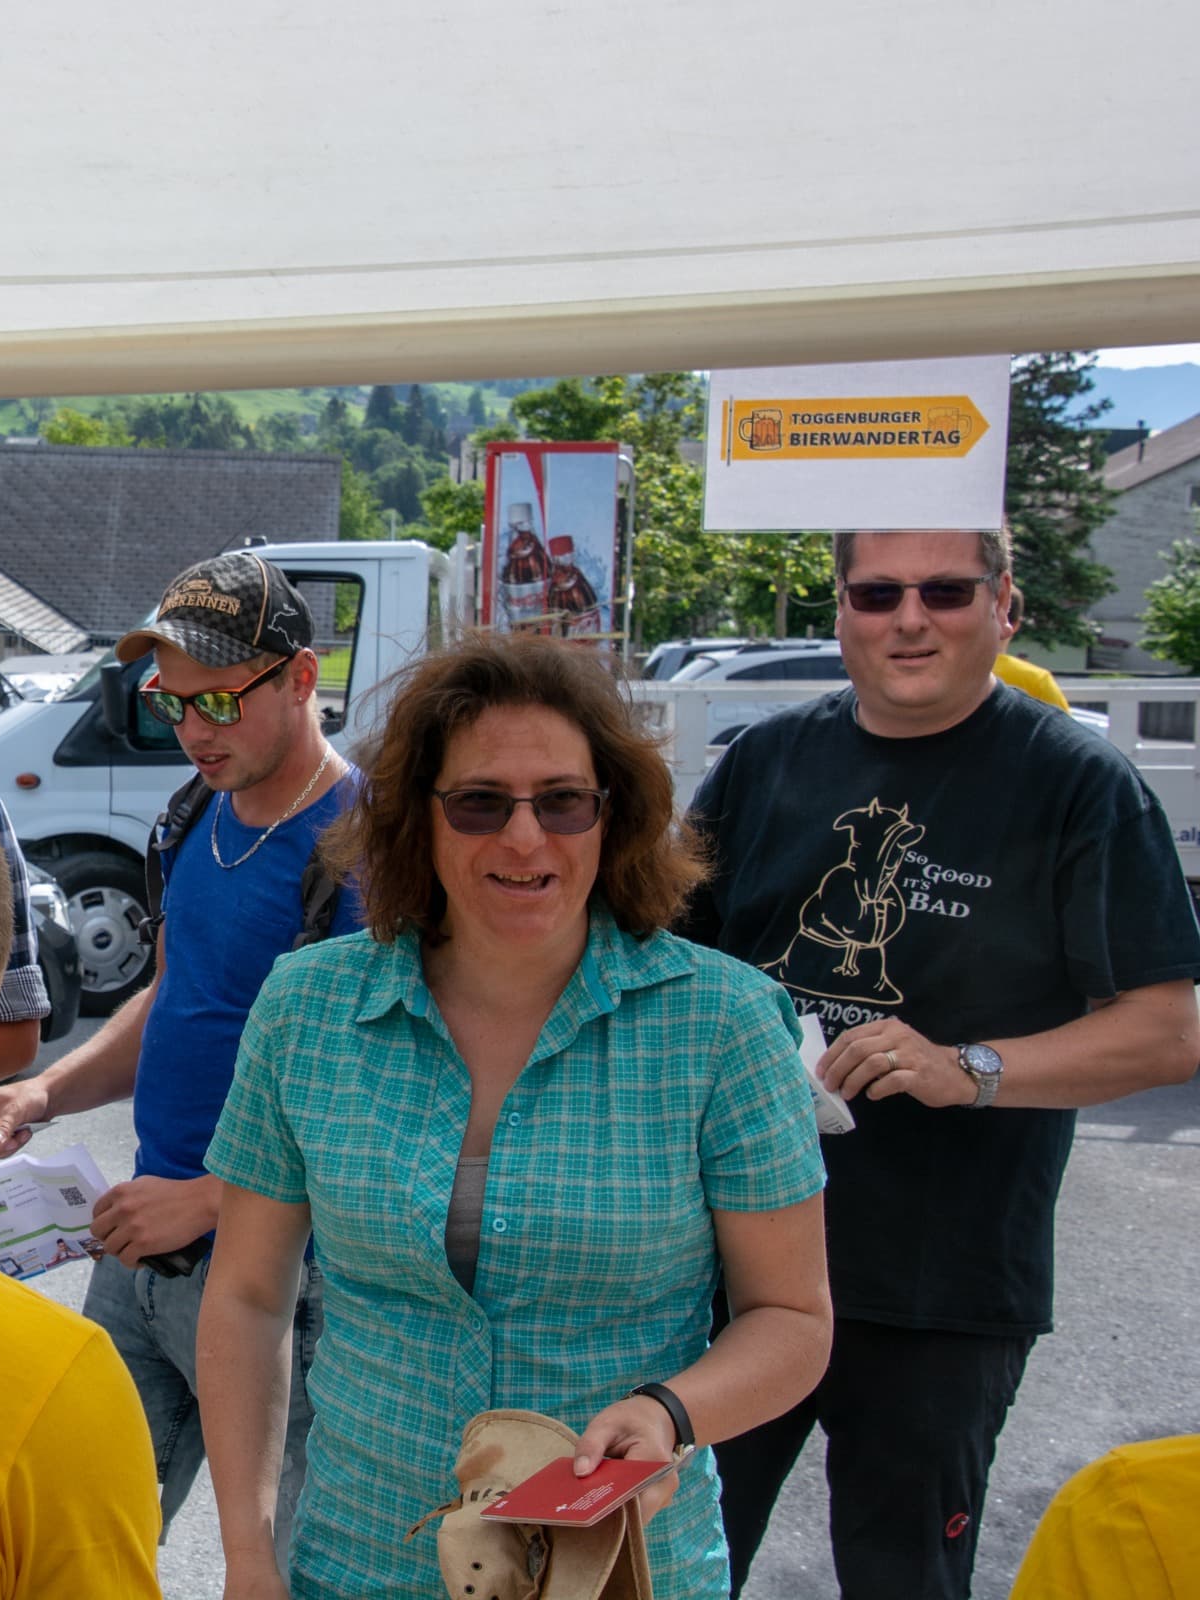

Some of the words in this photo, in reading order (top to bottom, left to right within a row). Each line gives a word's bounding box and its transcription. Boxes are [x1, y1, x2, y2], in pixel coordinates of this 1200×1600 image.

[791, 412, 921, 425] TOGGENBURGER
[789, 430, 961, 447] BIERWANDERTAG
[907, 890, 971, 918] BAD
